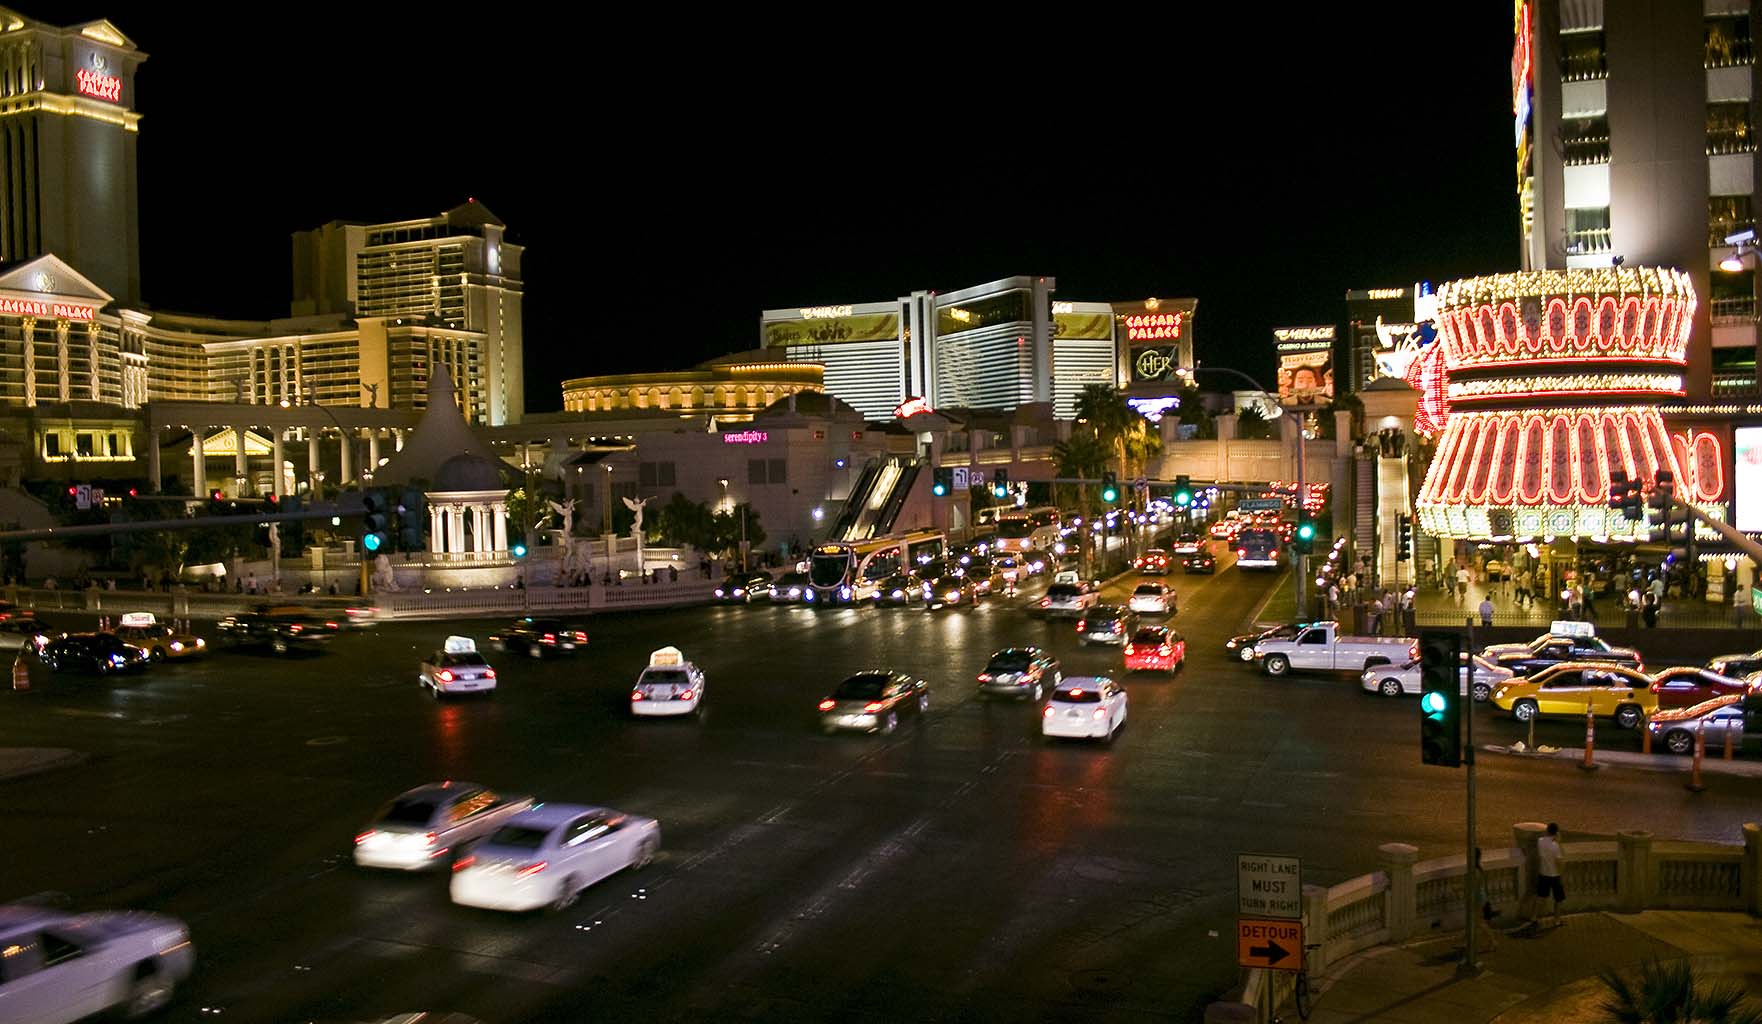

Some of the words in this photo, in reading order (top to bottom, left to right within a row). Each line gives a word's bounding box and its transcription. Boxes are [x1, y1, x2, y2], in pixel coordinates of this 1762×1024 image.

[76, 69, 121, 90] CAESARS
[80, 80, 120, 101] PALACE
[1367, 288, 1404, 300] TRUMP
[53, 303, 94, 320] PALACE
[812, 305, 853, 318] MIRAGE
[1126, 314, 1182, 328] CAESARS
[1128, 325, 1180, 340] PALACE
[1289, 327, 1334, 341] MIRAGE
[1306, 341, 1331, 349] RESORT
[1136, 349, 1173, 378] CHER
[724, 430, 762, 443] serendipity
[762, 432, 768, 441] 3
[1240, 861, 1268, 873] RIGHT
[1271, 863, 1297, 875] LANE
[1252, 879, 1287, 894] MUST
[1241, 897, 1267, 910] TURN
[1270, 900, 1299, 912] RIGHT
[1242, 925, 1298, 940] DETOUR
